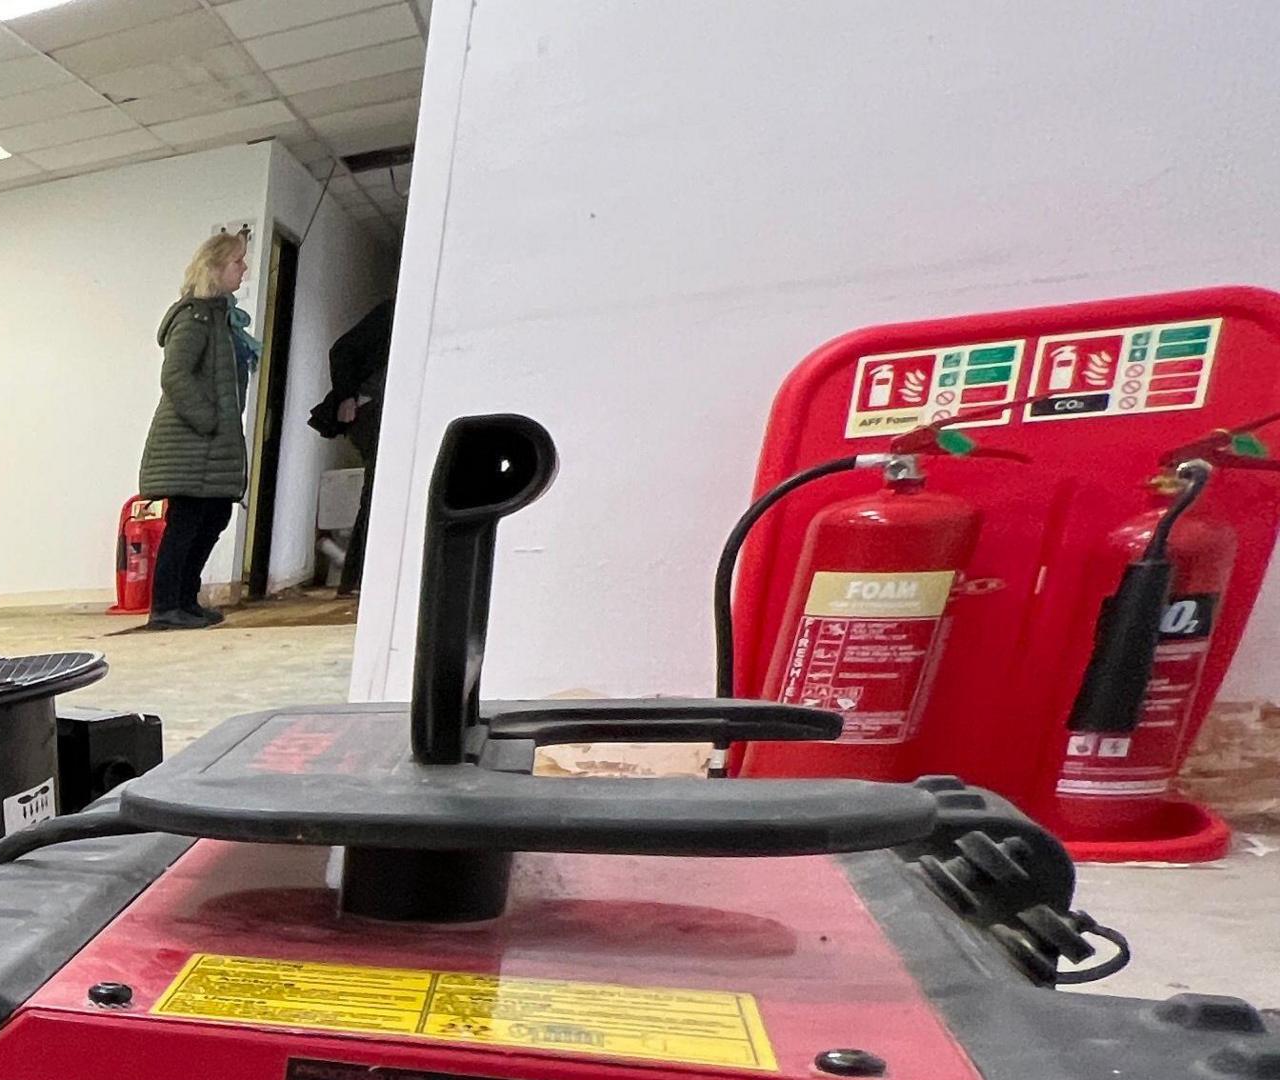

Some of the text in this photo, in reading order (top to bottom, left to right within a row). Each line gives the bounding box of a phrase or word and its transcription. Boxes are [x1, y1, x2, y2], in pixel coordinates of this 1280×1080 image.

[886, 415, 919, 426] Foam
[845, 580, 920, 600] FOAM
[1159, 600, 1199, 634] O2
